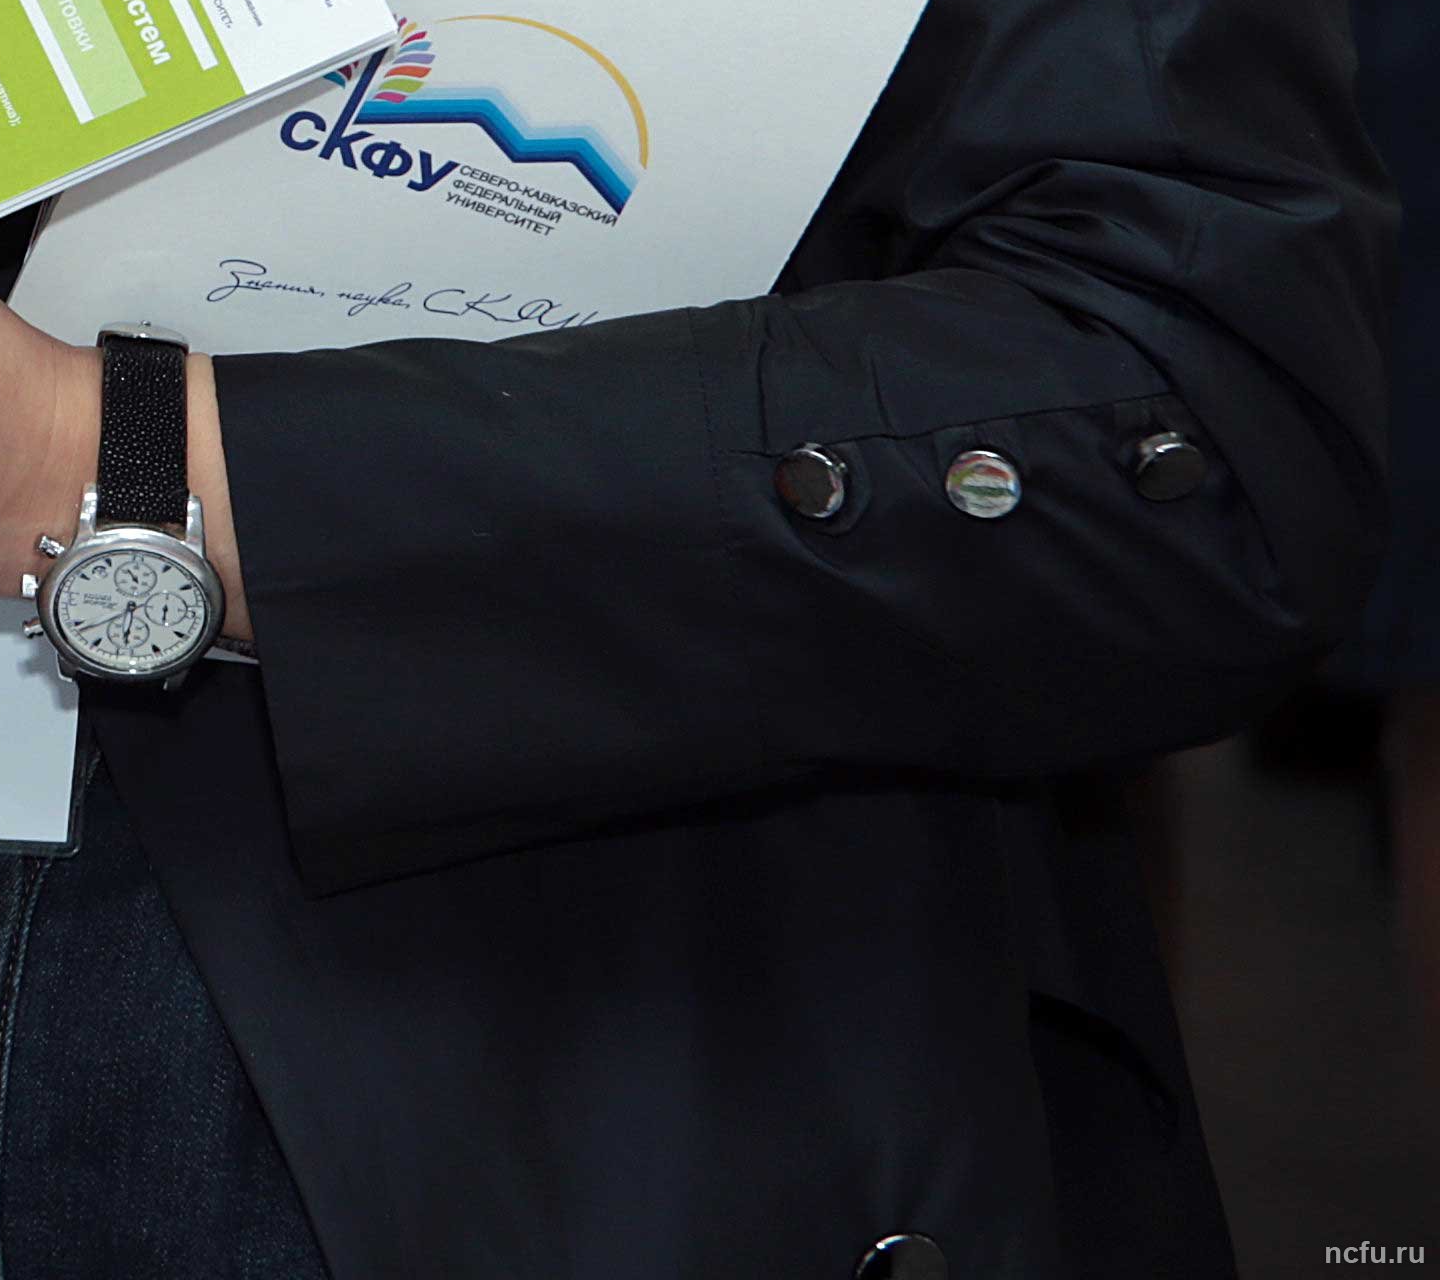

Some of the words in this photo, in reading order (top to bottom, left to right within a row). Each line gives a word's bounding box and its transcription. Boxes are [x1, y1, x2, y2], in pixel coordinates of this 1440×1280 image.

[279, 110, 461, 202] СКФУ
[445, 191, 555, 236] УНИВЕРСИТЕТ
[452, 178, 562, 223] ФЕДЕРАЛЬНЫЙ
[457, 162, 621, 227] СЕВЕРО-КАВКАЗСКИЙ
